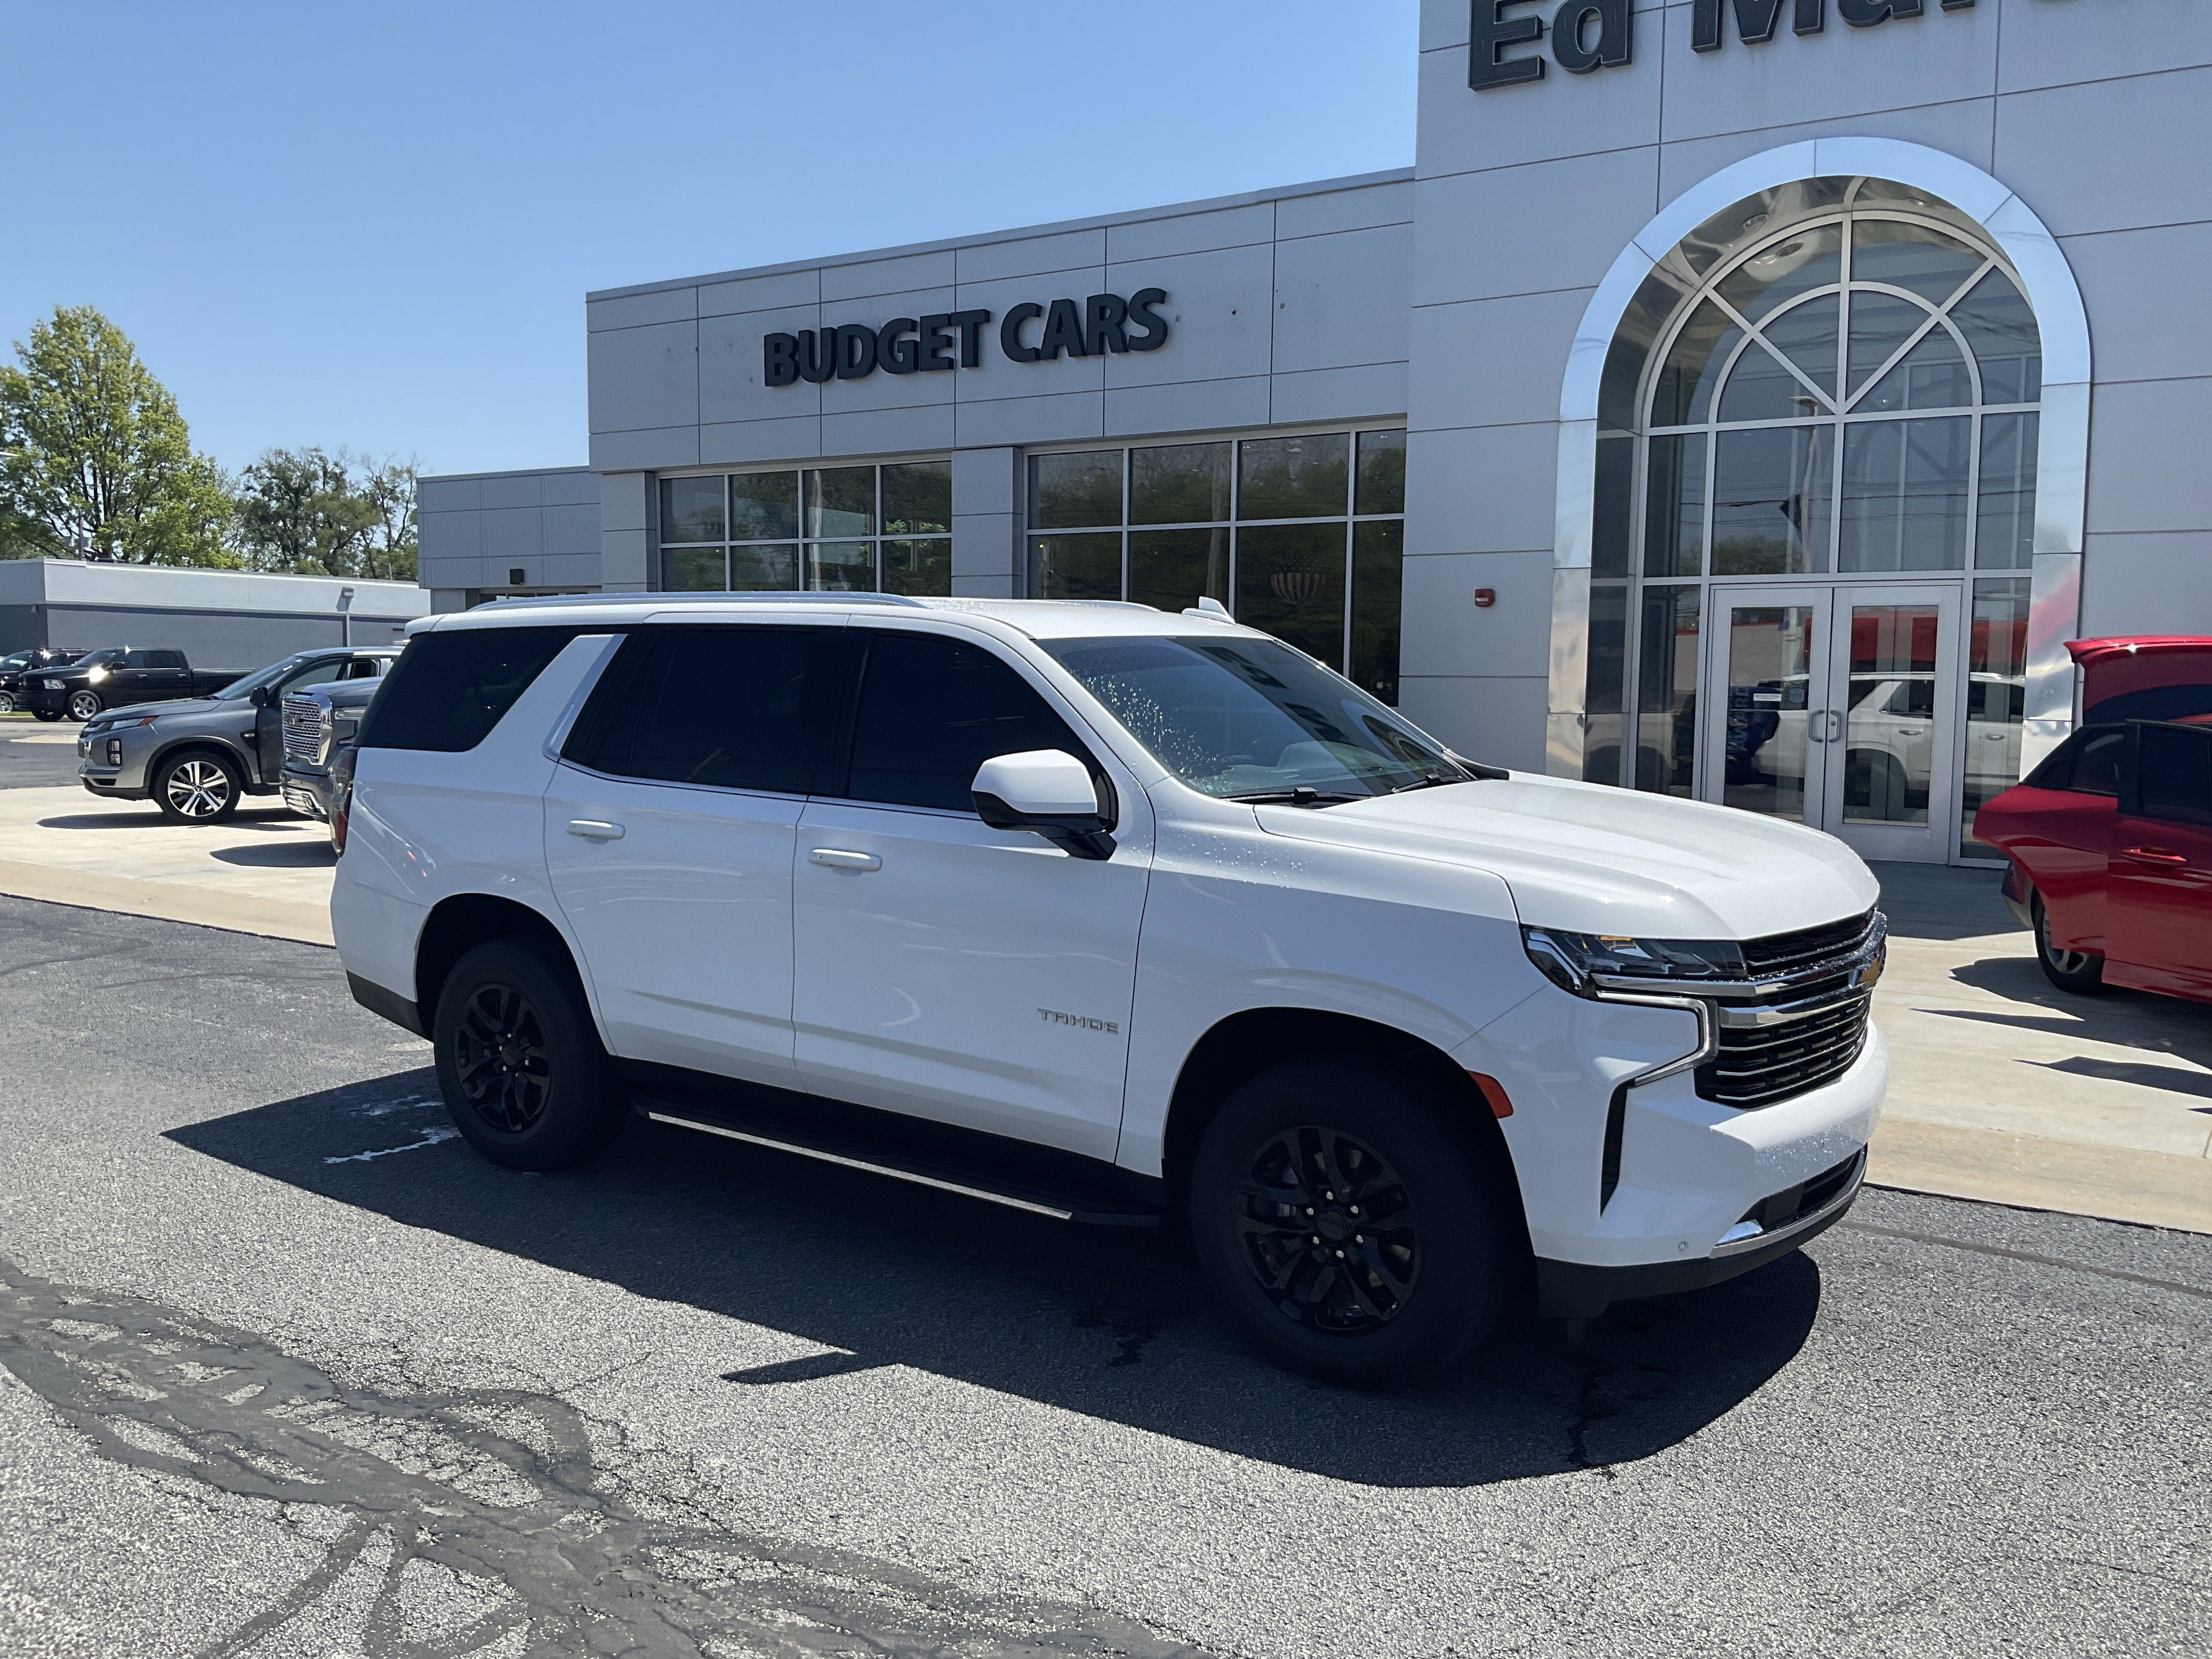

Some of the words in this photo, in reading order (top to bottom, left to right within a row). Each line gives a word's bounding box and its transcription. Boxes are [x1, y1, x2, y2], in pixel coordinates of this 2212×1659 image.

[764, 308, 991, 387] BUDGET
[1000, 287, 1167, 363] CARS
[1037, 1008, 1119, 1034] TAHOE
